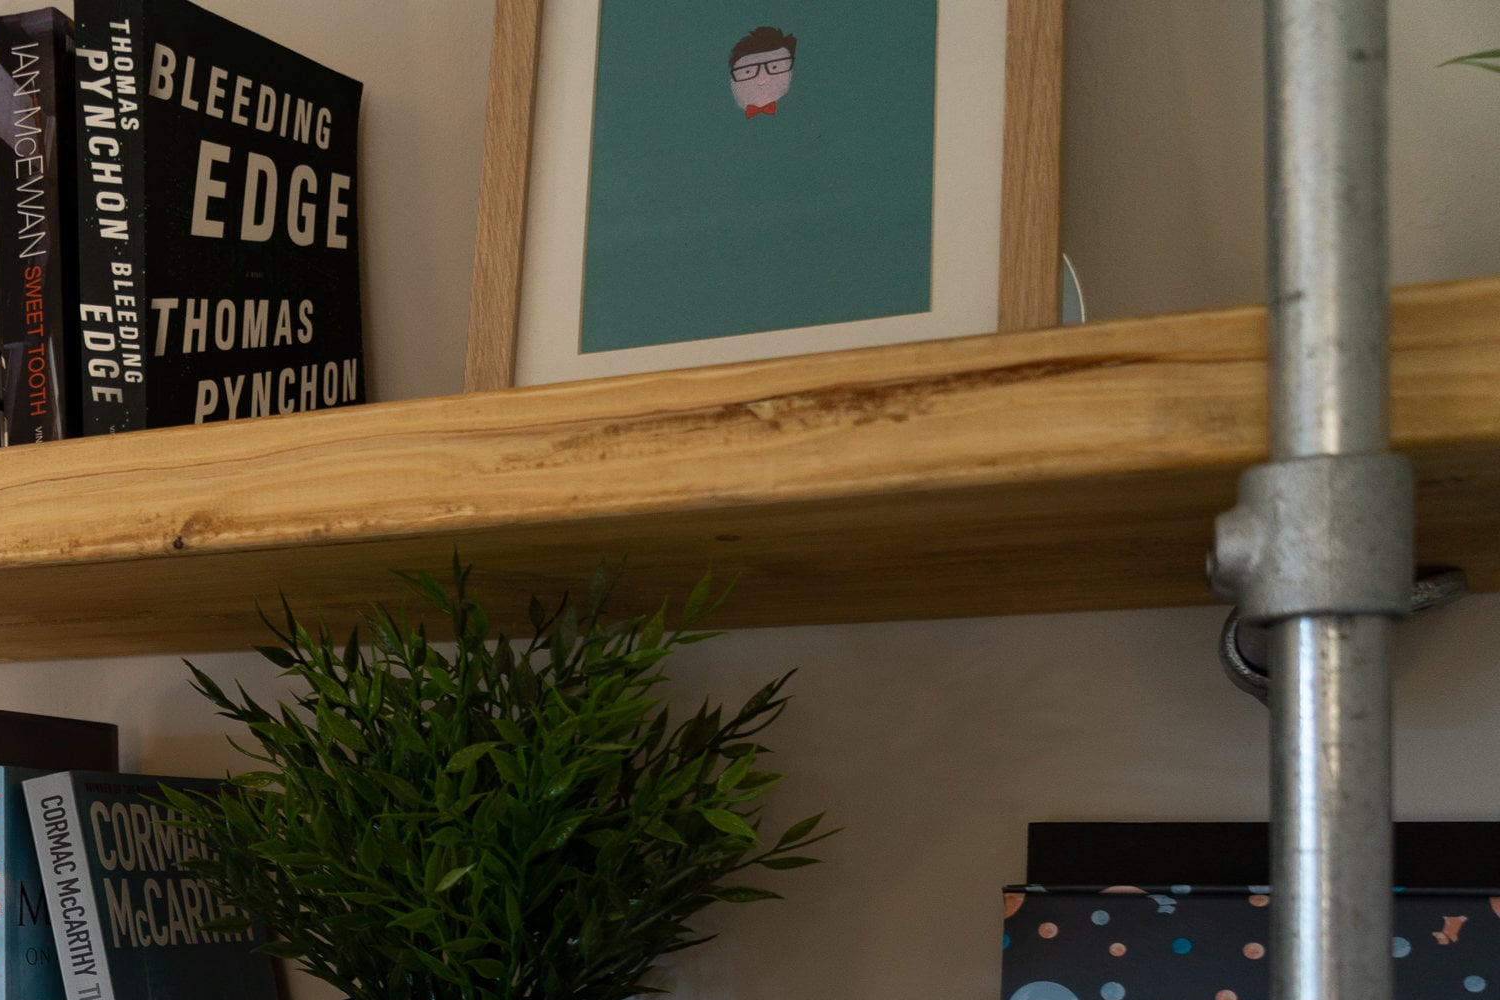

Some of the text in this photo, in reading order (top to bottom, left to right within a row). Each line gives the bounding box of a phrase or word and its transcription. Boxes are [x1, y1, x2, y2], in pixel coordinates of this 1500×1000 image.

[109, 19, 140, 131] THOMAS
[148, 42, 333, 150] BLEEDING
[75, 48, 129, 241] PYNCHON
[190, 139, 351, 250] EDGE
[11, 42, 47, 417] IAN McEWAN SWEET TOOTH
[80, 303, 123, 403] EDGE
[111, 262, 143, 384] BLEEDING
[151, 298, 315, 357] THOMAS
[194, 358, 357, 425] PYNCHON
[41, 794, 76, 874] CORMAC
[57, 880, 98, 976] McCARTHY
